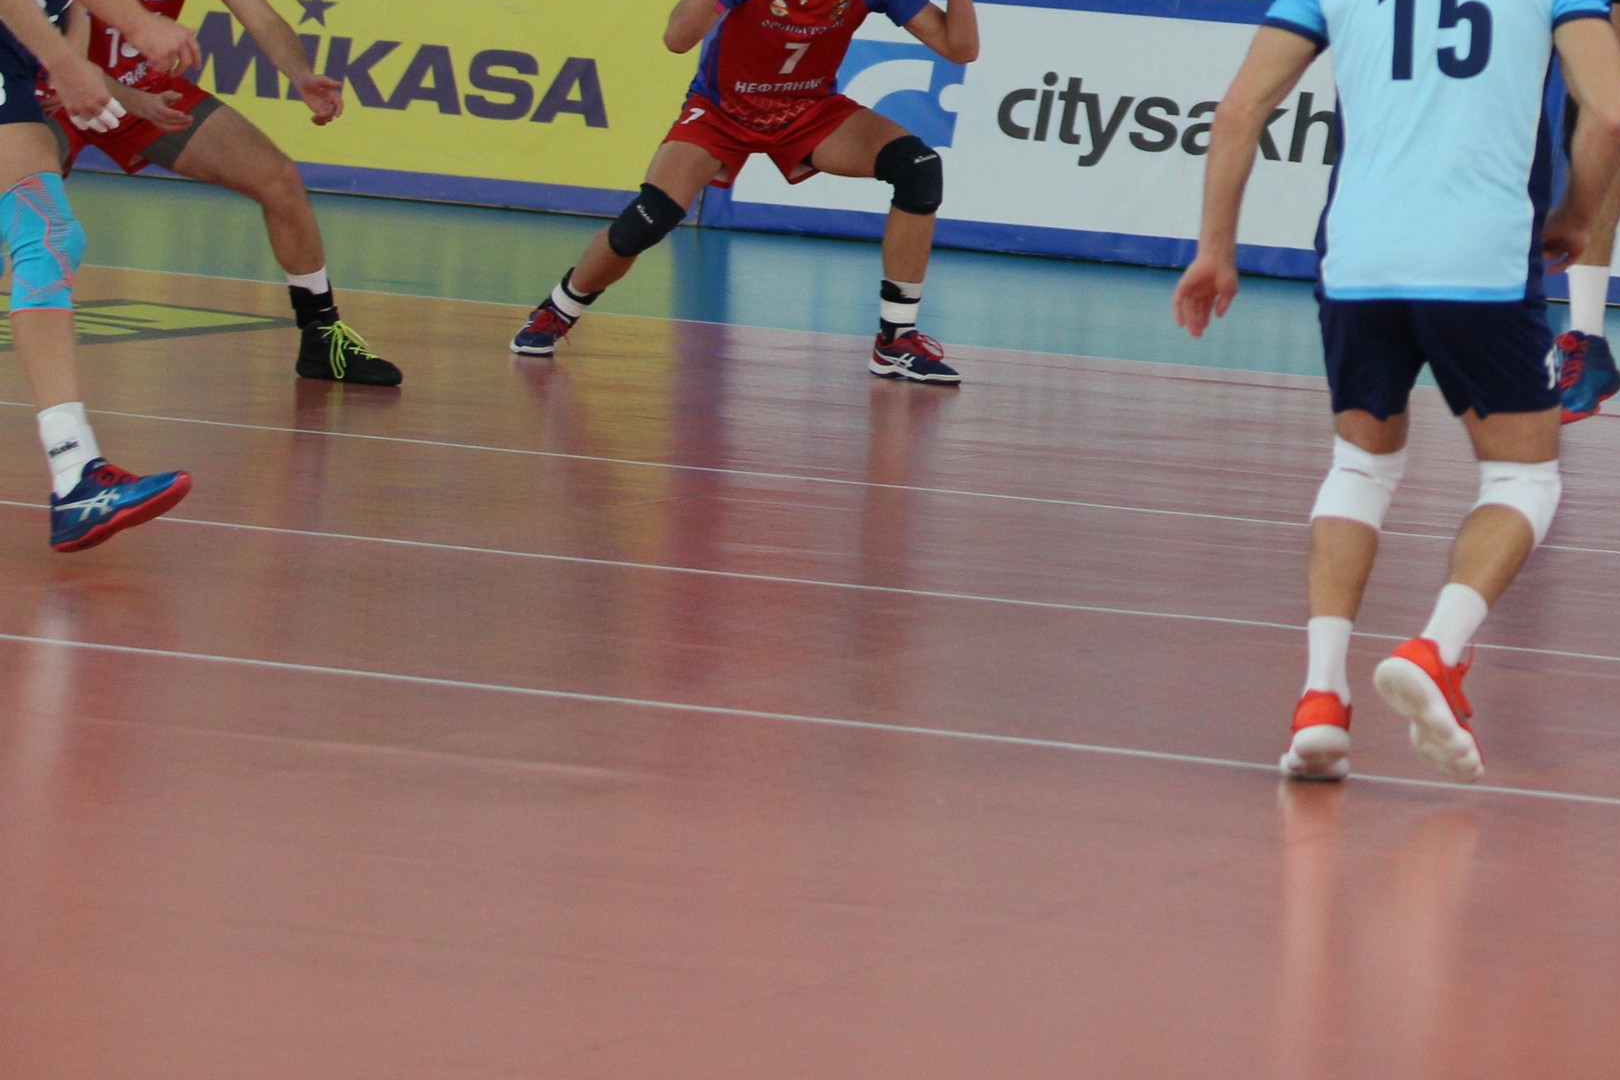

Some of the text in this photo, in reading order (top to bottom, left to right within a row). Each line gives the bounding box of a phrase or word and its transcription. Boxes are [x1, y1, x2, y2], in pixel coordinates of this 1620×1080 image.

[183, 10, 609, 129] MIKASA
[778, 42, 811, 74] 7
[997, 70, 1339, 167] citysakh
[1544, 343, 1561, 391] 1
